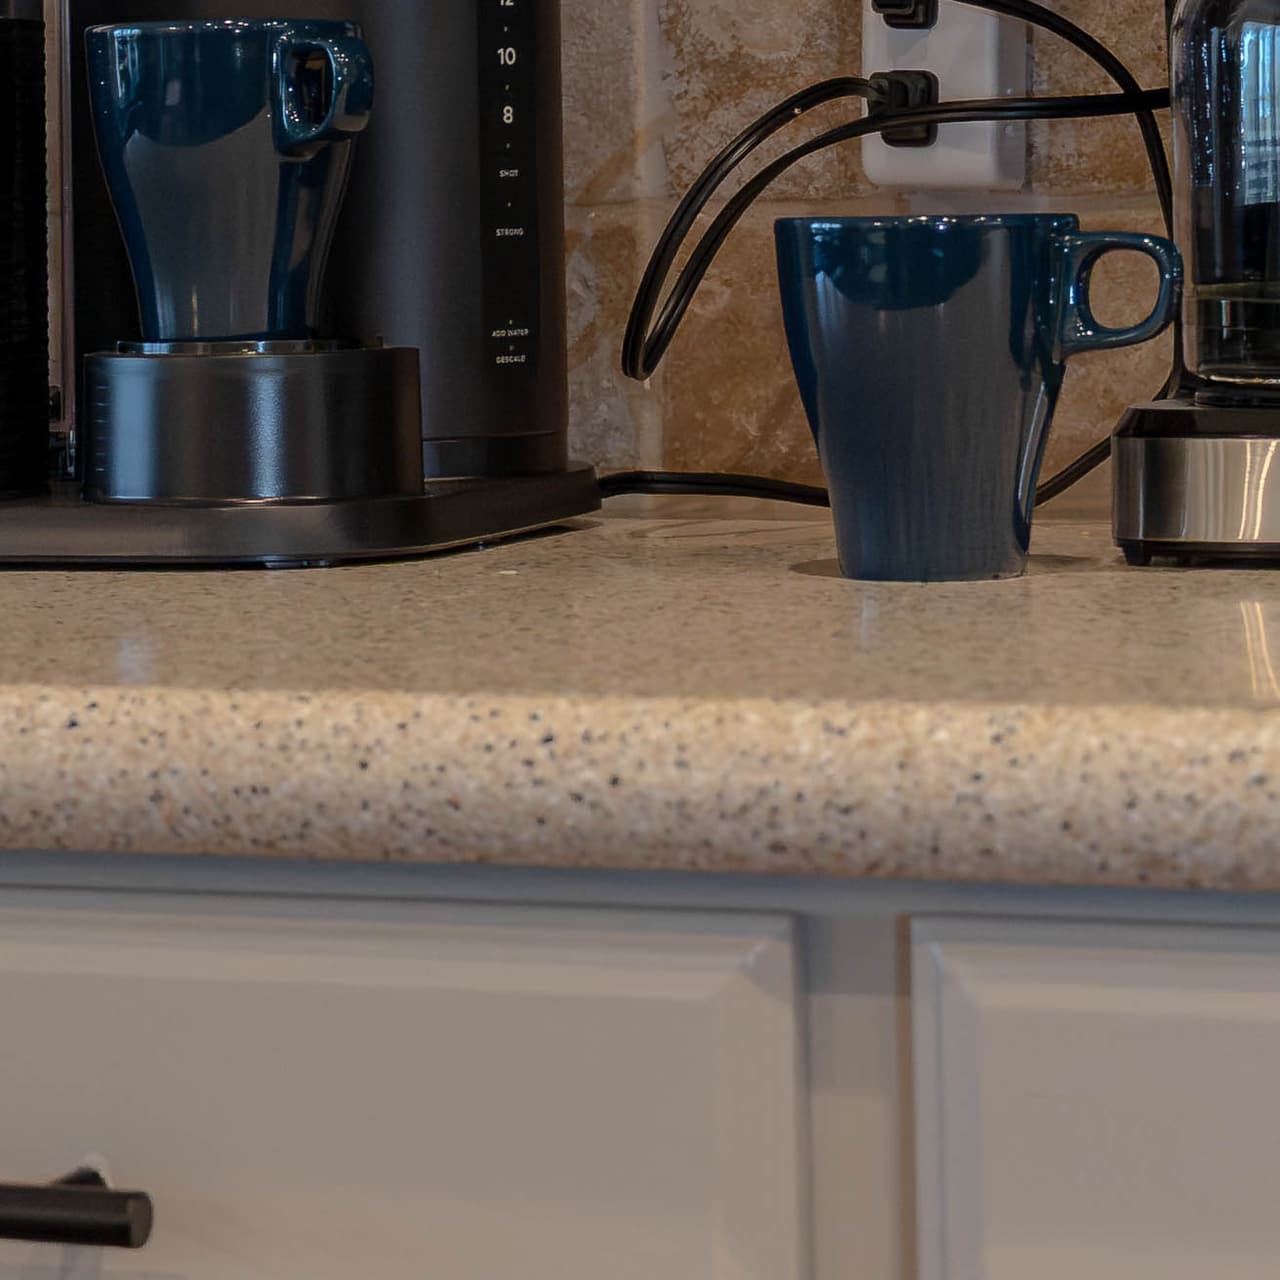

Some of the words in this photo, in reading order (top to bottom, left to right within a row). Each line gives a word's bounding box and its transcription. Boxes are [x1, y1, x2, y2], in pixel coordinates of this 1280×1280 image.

[497, 47, 516, 65] 10
[503, 106, 513, 123] 8
[496, 228, 524, 236] STRONG
[496, 355, 526, 364] DESCALE
